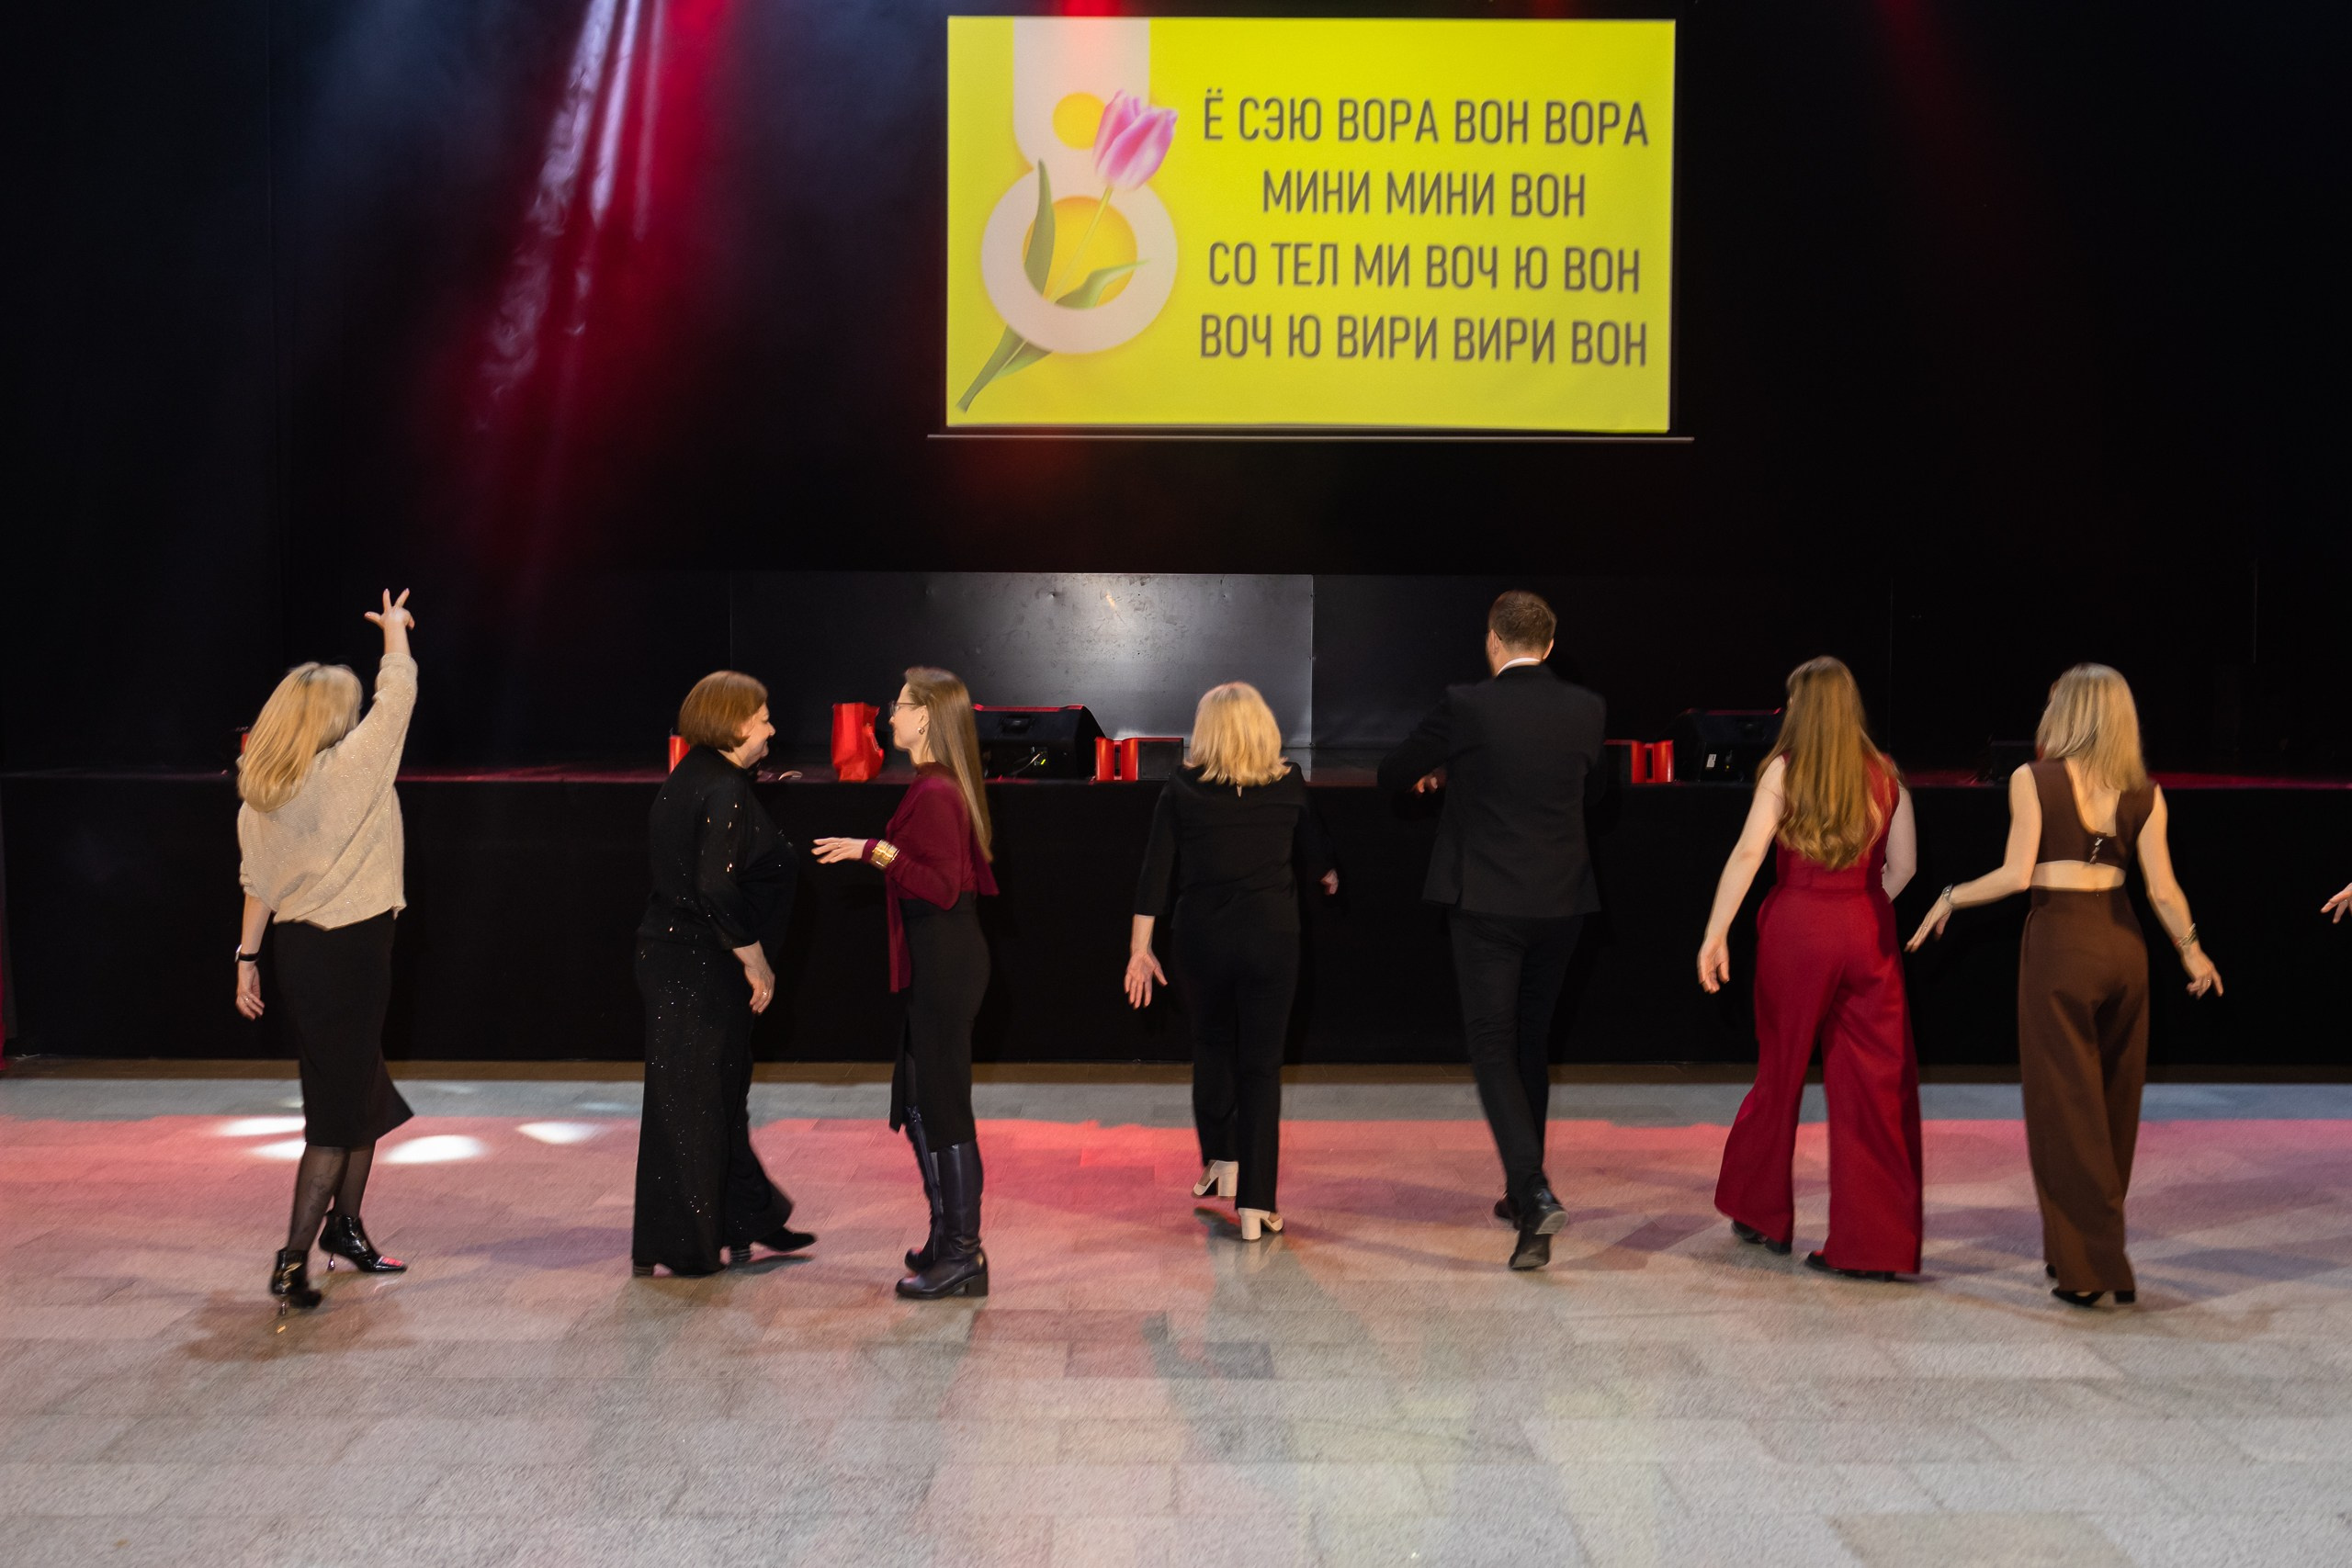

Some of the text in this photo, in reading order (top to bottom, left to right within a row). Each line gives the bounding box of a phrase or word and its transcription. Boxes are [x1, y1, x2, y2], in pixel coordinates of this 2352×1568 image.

[1204, 88, 1650, 148] Ё СЭЮ ВОРА ВОН ВОРА
[1263, 170, 1586, 219] МИНИ МИНИ ВОН
[1209, 242, 1641, 295] СО ТЕЛ МИ ВОЧ Ю ВОН
[1200, 314, 1647, 368] ВОЧ Ю ВИРИ ВИРИ ВОН
